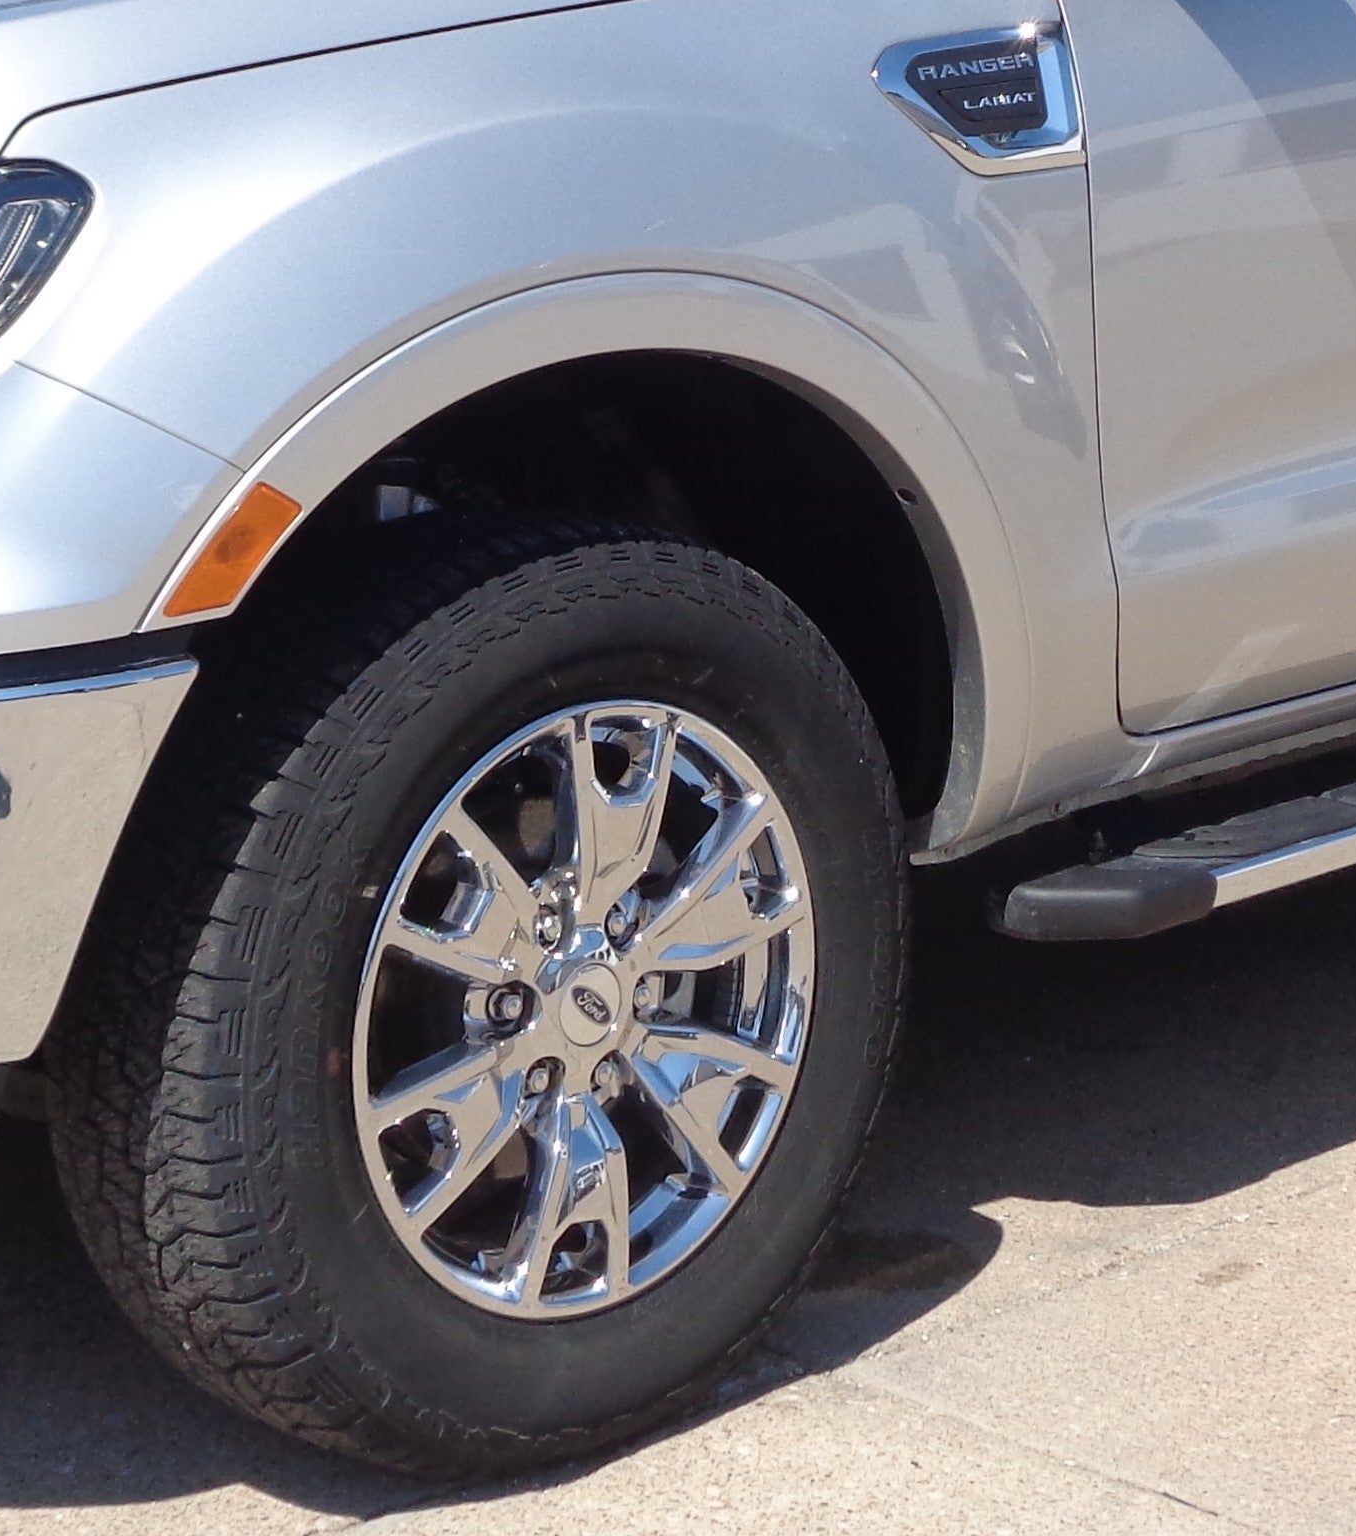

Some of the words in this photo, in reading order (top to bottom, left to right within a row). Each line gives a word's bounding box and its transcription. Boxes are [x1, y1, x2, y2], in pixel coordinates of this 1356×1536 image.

[916, 52, 1035, 82] RANGER
[963, 91, 1036, 110] LARIAT
[577, 991, 607, 1022] Ford
